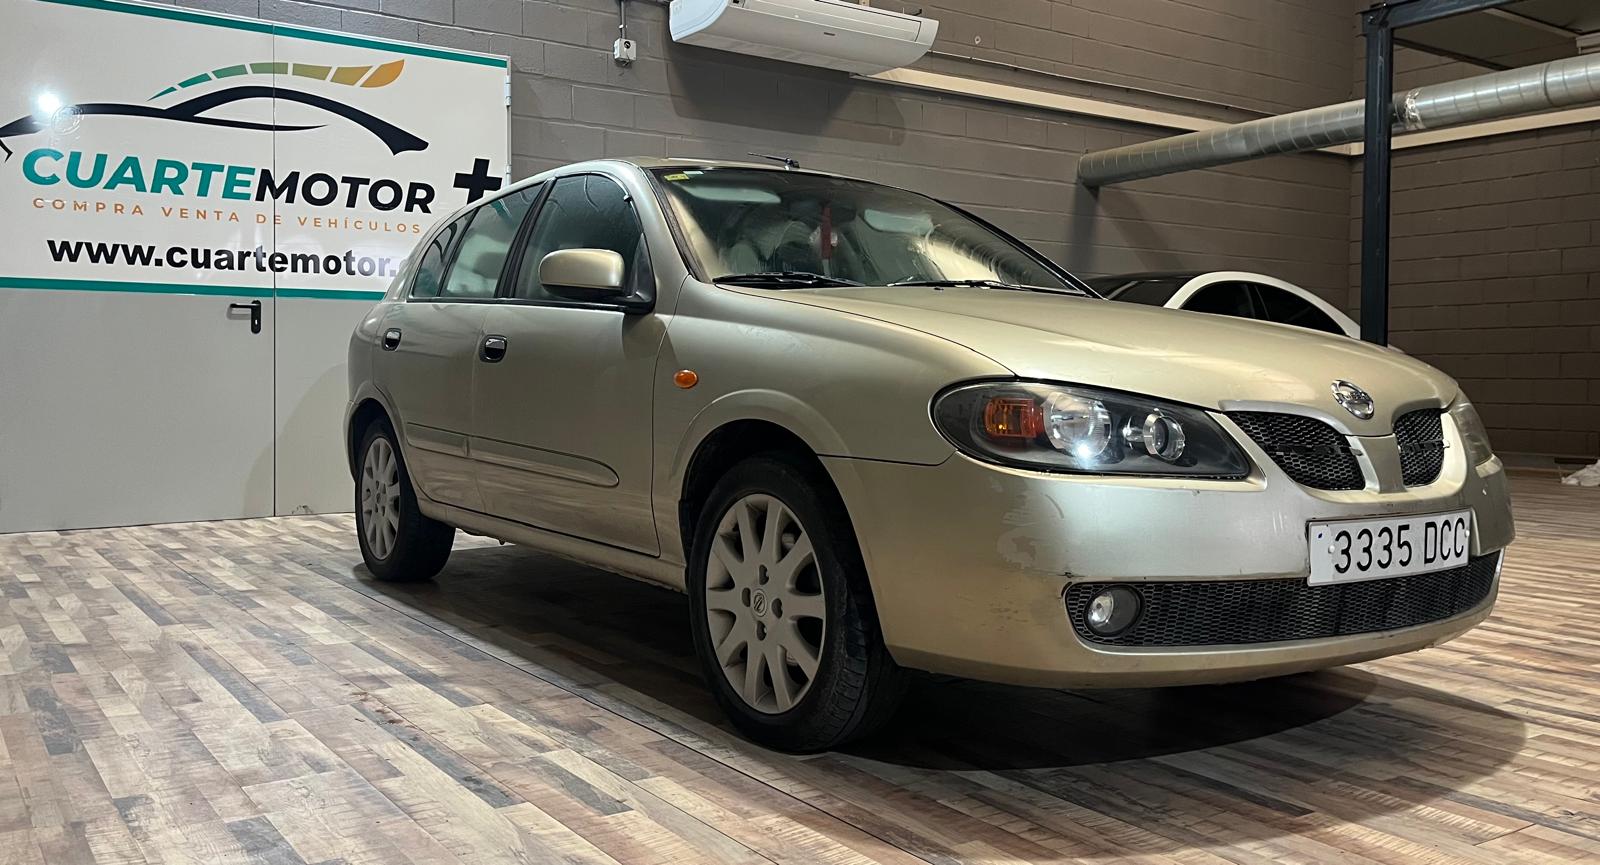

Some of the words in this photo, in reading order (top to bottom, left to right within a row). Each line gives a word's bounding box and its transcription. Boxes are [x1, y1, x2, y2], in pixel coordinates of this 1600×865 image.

[21, 147, 437, 214] CUARTEMOTOR
[32, 197, 144, 216] COMPRA
[161, 206, 240, 223] VENTA
[256, 213, 283, 225] DE
[297, 215, 421, 234] VEHÍCULOS
[47, 238, 407, 278] www.cuartemotor.
[1333, 523, 1412, 574] 3335
[1423, 516, 1466, 565] DCC
